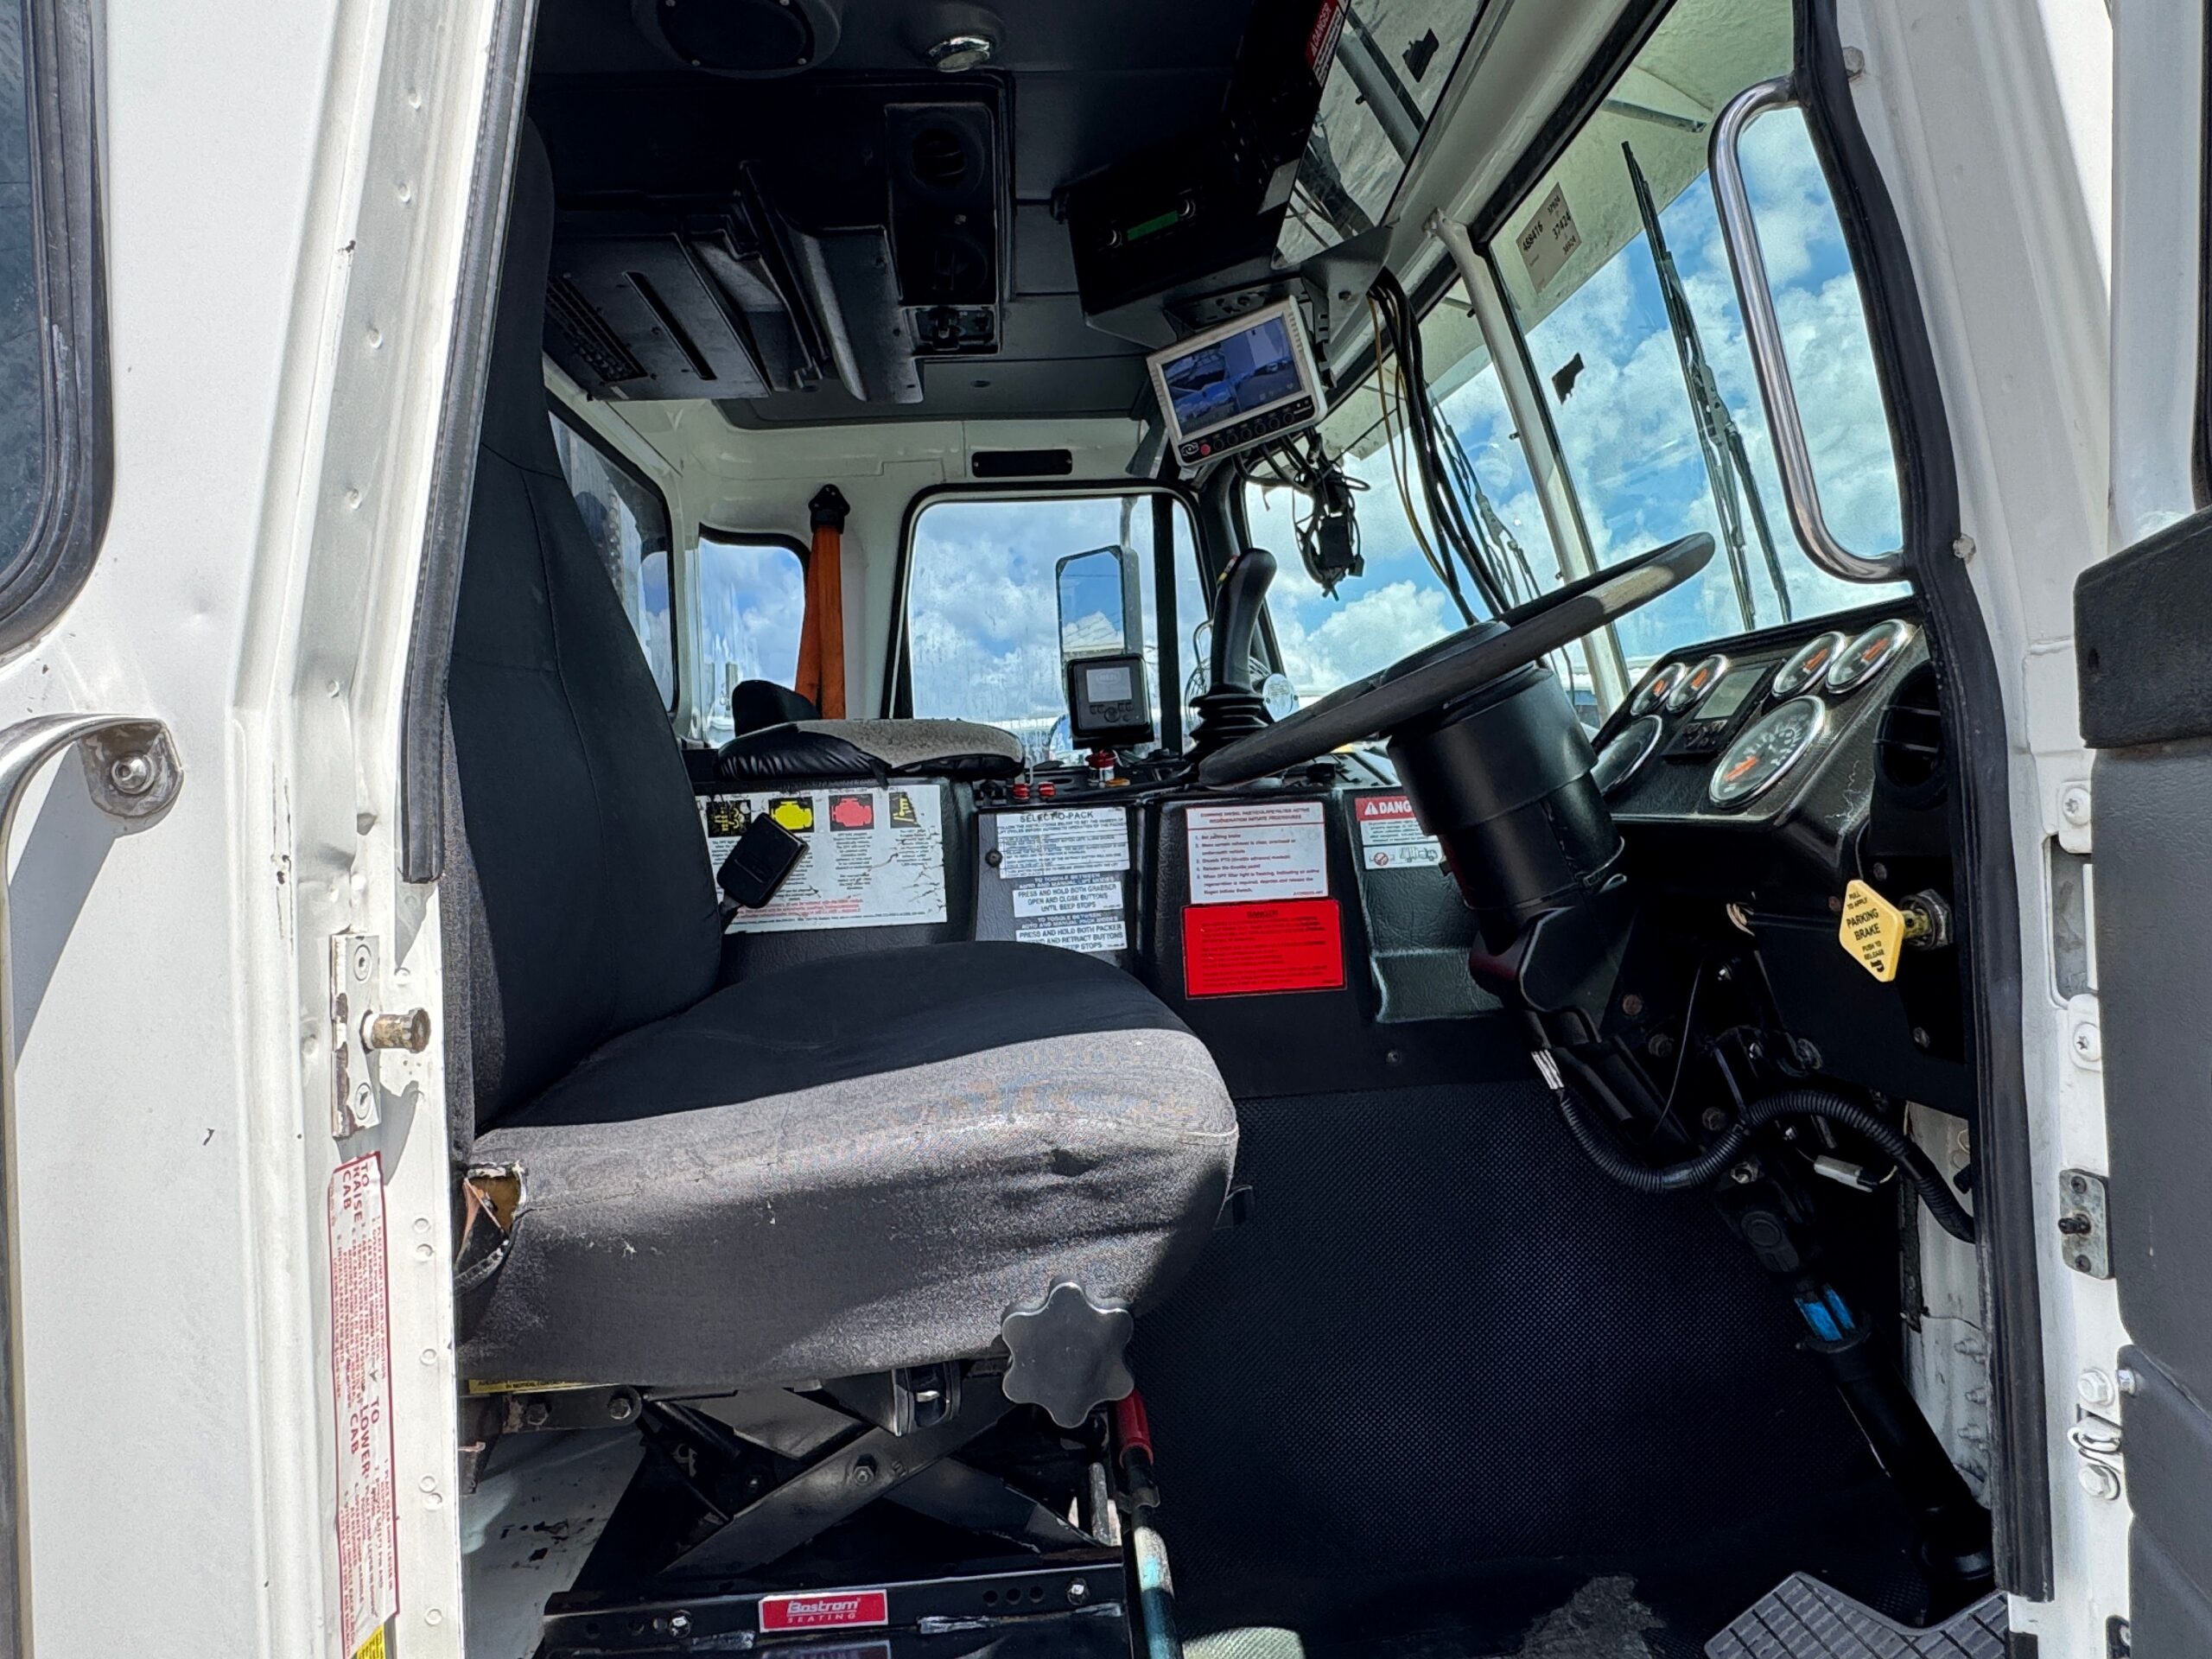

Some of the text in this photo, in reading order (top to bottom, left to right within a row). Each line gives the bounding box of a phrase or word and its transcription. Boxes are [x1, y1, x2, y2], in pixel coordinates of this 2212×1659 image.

[1312, 3, 1332, 48] DANGER
[1848, 891, 1861, 899] PULL
[1853, 897, 1867, 907] APPLY
[1846, 908, 1879, 929] PARKING
[1092, 931, 1123, 940] BUTTONS
[1096, 924, 1122, 932] PACKER
[1853, 923, 1881, 941] BRAKE
[1862, 942, 1874, 952] PUSH
[1864, 950, 1885, 960] RELEASE
[361, 1162, 370, 1187] TO
[343, 1170, 352, 1211] CAB
[353, 1166, 363, 1224] RAISE
[371, 1395, 379, 1424] TO
[350, 1413, 359, 1455] CAB
[359, 1404, 371, 1477] LOWER
[787, 1599, 859, 1615] Bostrom
[786, 1612, 857, 1624] SEATING
